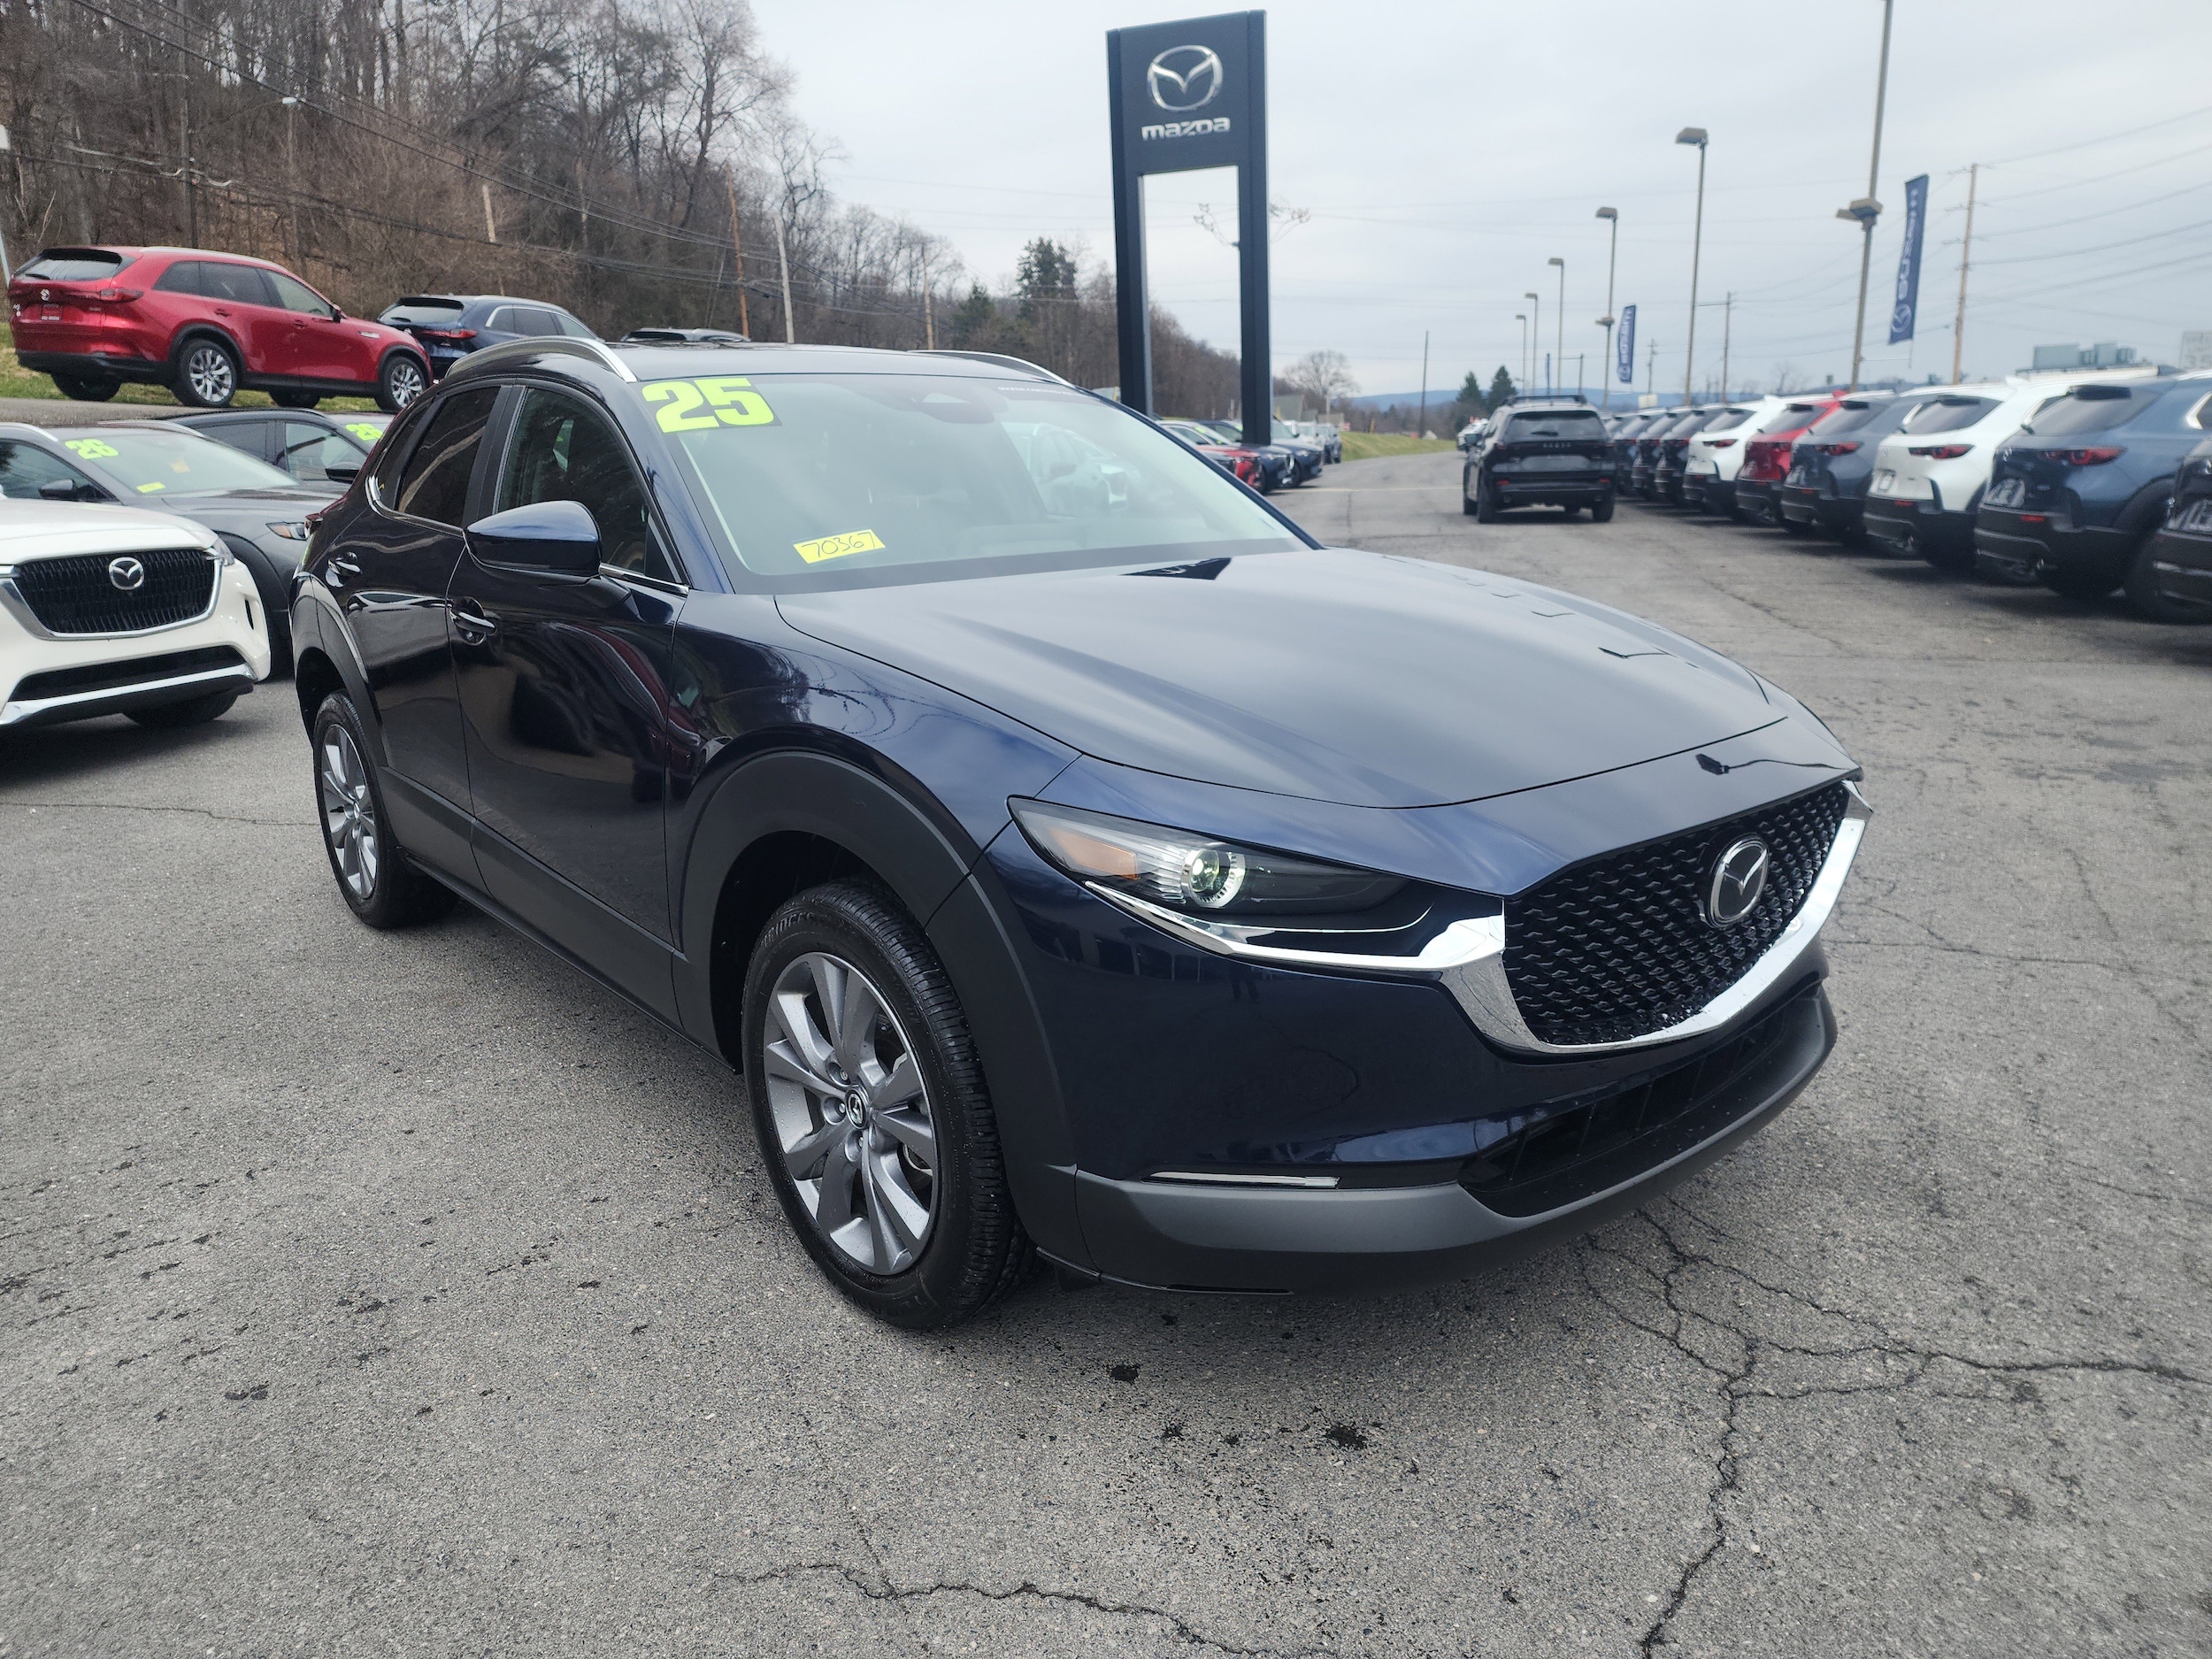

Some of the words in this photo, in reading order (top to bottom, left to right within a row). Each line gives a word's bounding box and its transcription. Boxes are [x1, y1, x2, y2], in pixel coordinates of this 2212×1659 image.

[1141, 117, 1231, 142] mazda
[641, 378, 774, 434] 25
[65, 438, 119, 460] 26
[801, 531, 876, 558] 70367
